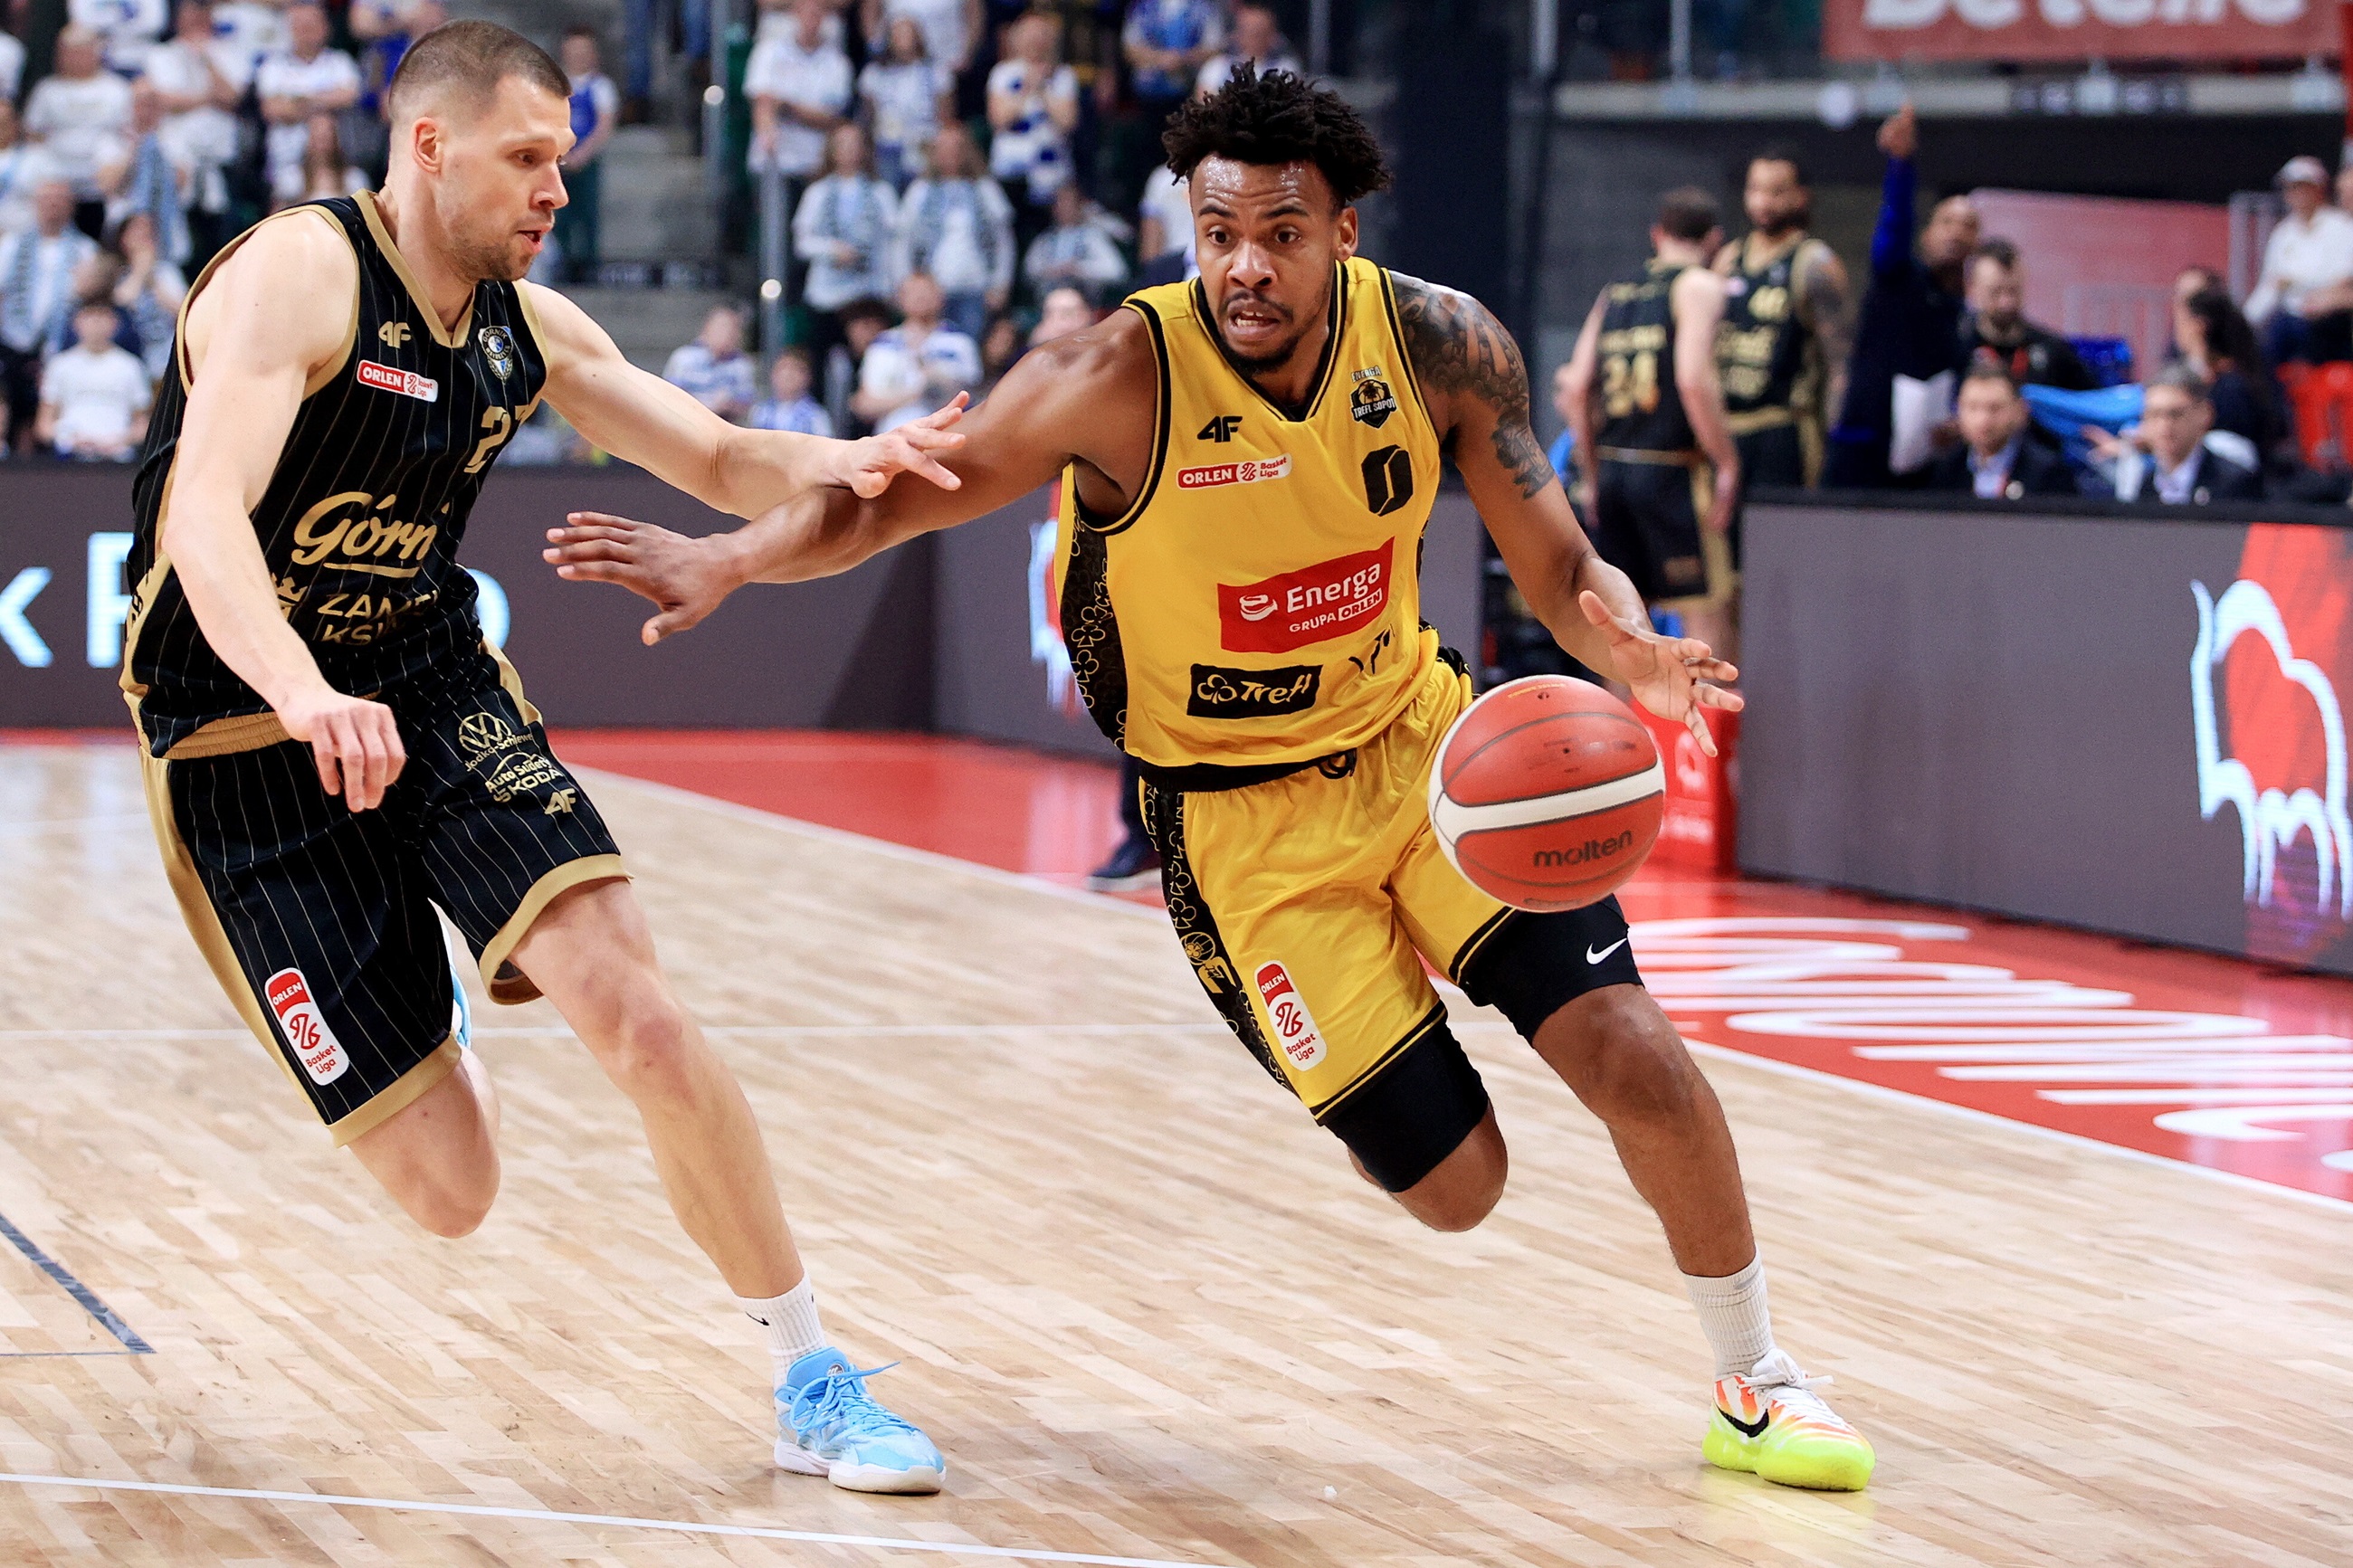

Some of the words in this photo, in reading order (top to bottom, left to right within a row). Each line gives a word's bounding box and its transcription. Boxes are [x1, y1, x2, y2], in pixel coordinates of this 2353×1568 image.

[362, 367, 404, 387] ORLEN
[1351, 366, 1382, 383] ENERGA
[1353, 404, 1373, 419] TREFL
[1196, 415, 1243, 443] 4F
[1260, 457, 1287, 470] Basket
[1182, 468, 1233, 485] ORLEN
[1260, 470, 1279, 479] Liga
[1286, 563, 1381, 613] Energa
[1289, 613, 1337, 632] GRUPA
[1341, 593, 1380, 617] ORLEN
[1240, 673, 1312, 704] Trefl
[485, 769, 516, 794] Auto
[1533, 830, 1633, 867] molten
[272, 982, 302, 1005] ORLEN
[1262, 974, 1285, 993] ORLEN
[1286, 1033, 1316, 1054] Basket
[1295, 1046, 1315, 1060] Liga
[306, 1045, 336, 1067] Basket
[316, 1059, 336, 1074] Liga
